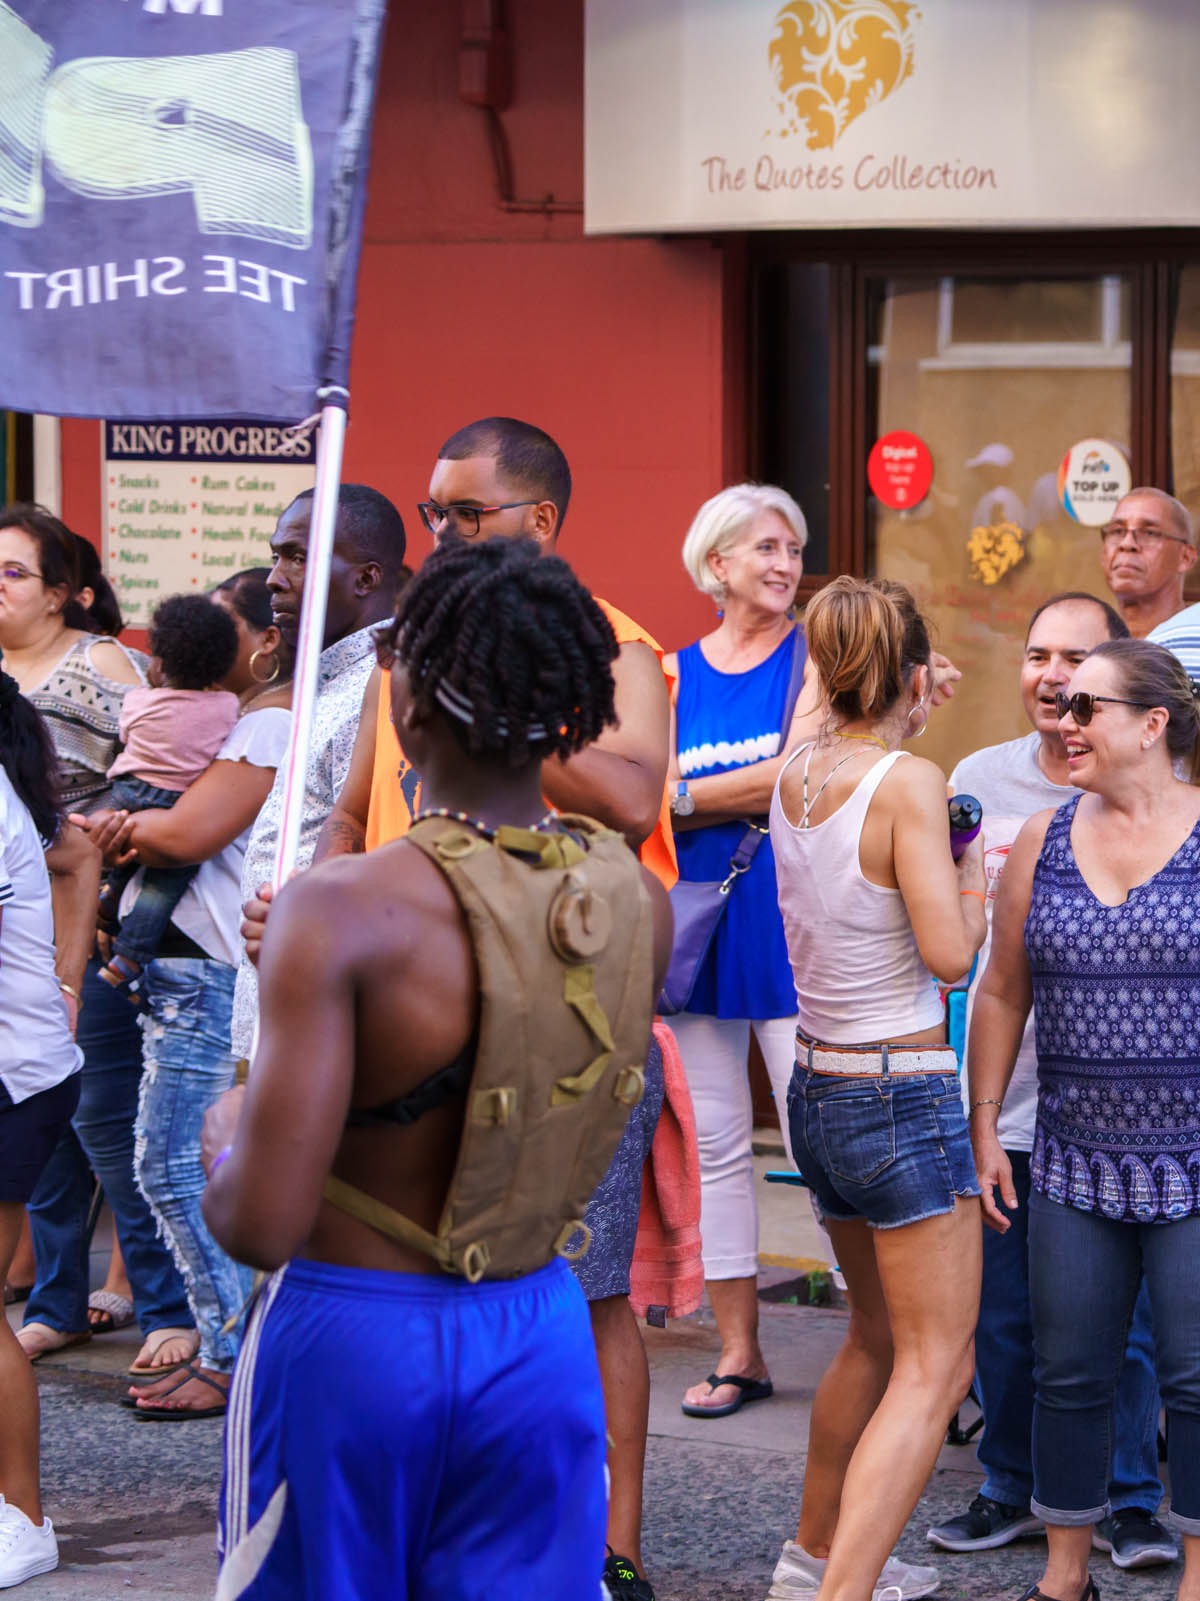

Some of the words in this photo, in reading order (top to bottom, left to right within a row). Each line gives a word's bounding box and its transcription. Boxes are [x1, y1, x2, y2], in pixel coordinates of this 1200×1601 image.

[702, 156, 746, 193] The
[753, 155, 843, 191] Quotes
[853, 154, 997, 191] Collection
[112, 425, 175, 455] KING
[180, 426, 312, 457] PROGRESS
[119, 474, 159, 489] Snacks
[202, 475, 230, 489] Rum
[236, 476, 275, 491] Cakes
[1073, 481, 1098, 492] TOP
[1102, 481, 1119, 492] UP
[118, 499, 145, 514] Cold
[149, 500, 187, 515] Drinks
[118, 524, 182, 540] Chocolate
